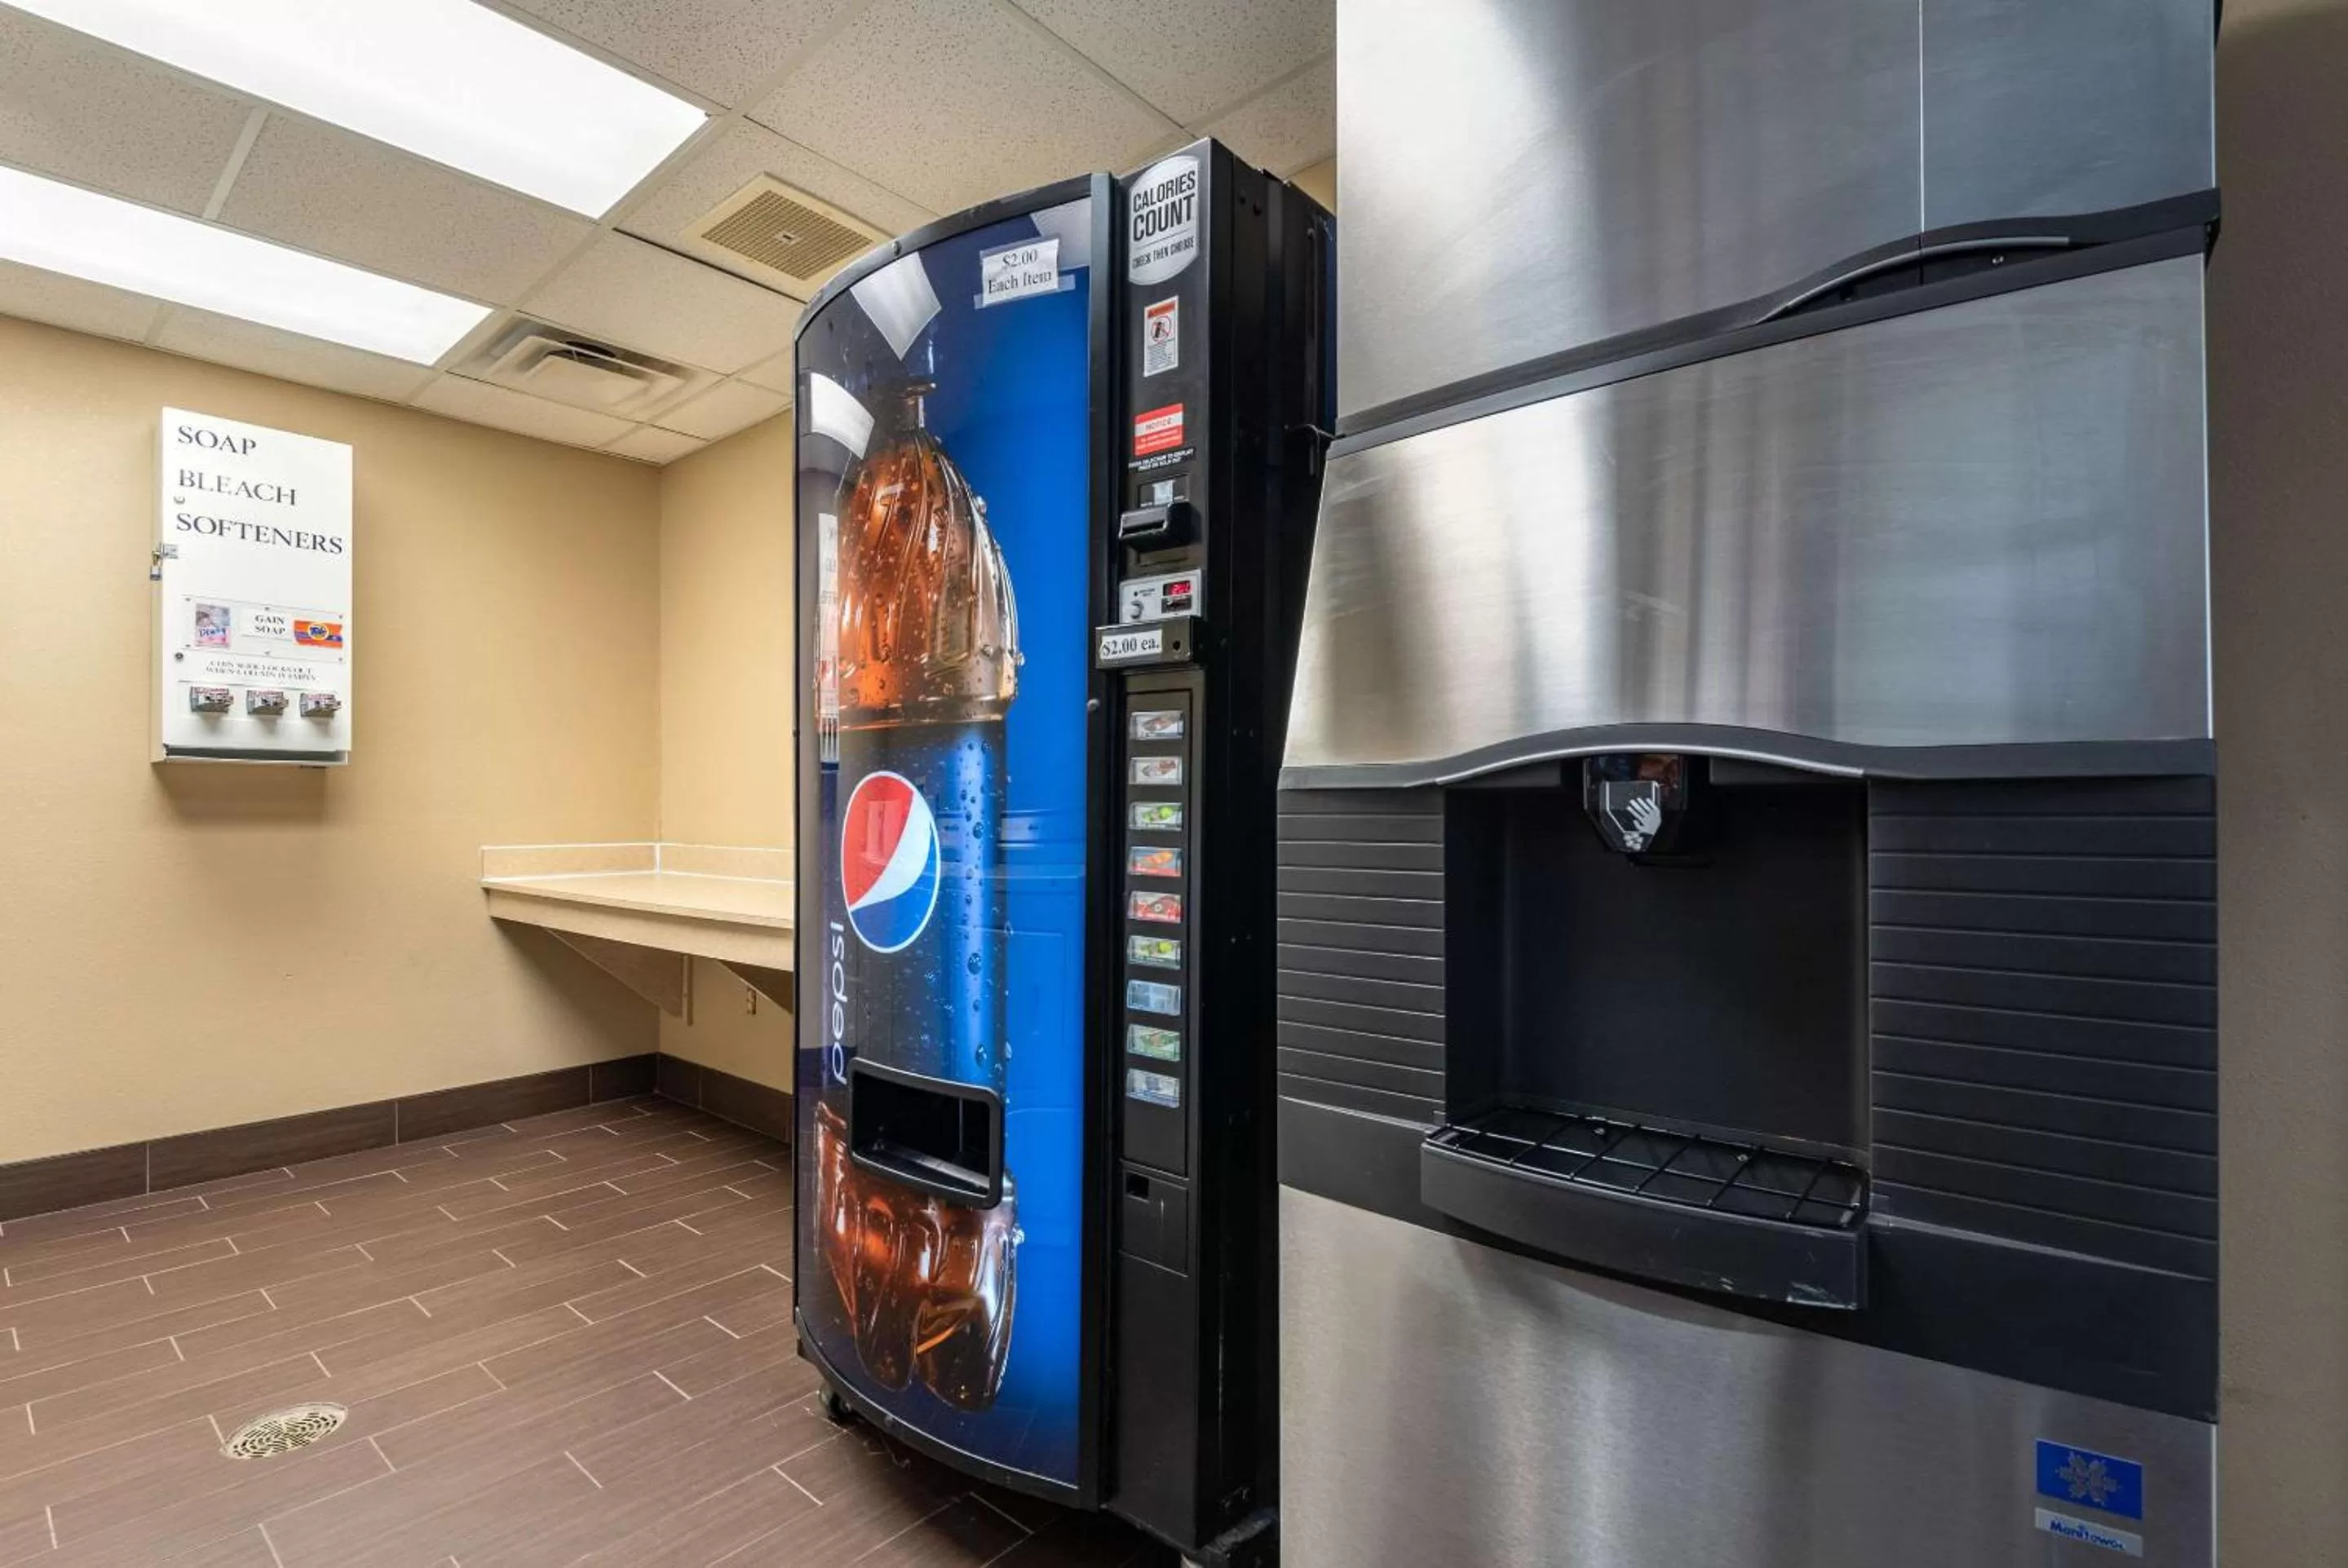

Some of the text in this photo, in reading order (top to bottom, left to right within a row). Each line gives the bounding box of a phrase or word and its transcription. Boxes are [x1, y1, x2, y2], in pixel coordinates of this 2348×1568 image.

[1133, 170, 1196, 213] CALORIES
[1133, 192, 1196, 242] COUNT
[1002, 248, 1038, 268] $2.00
[988, 272, 1052, 294] Each Item
[177, 425, 257, 455] SOAP
[179, 468, 296, 506] BLEACH
[175, 513, 343, 555] SOFTENERS
[254, 614, 285, 625] GAIN
[254, 625, 286, 634] SOAP
[1103, 638, 1160, 656] $2.00 ea.
[830, 921, 848, 1086] pepsi
